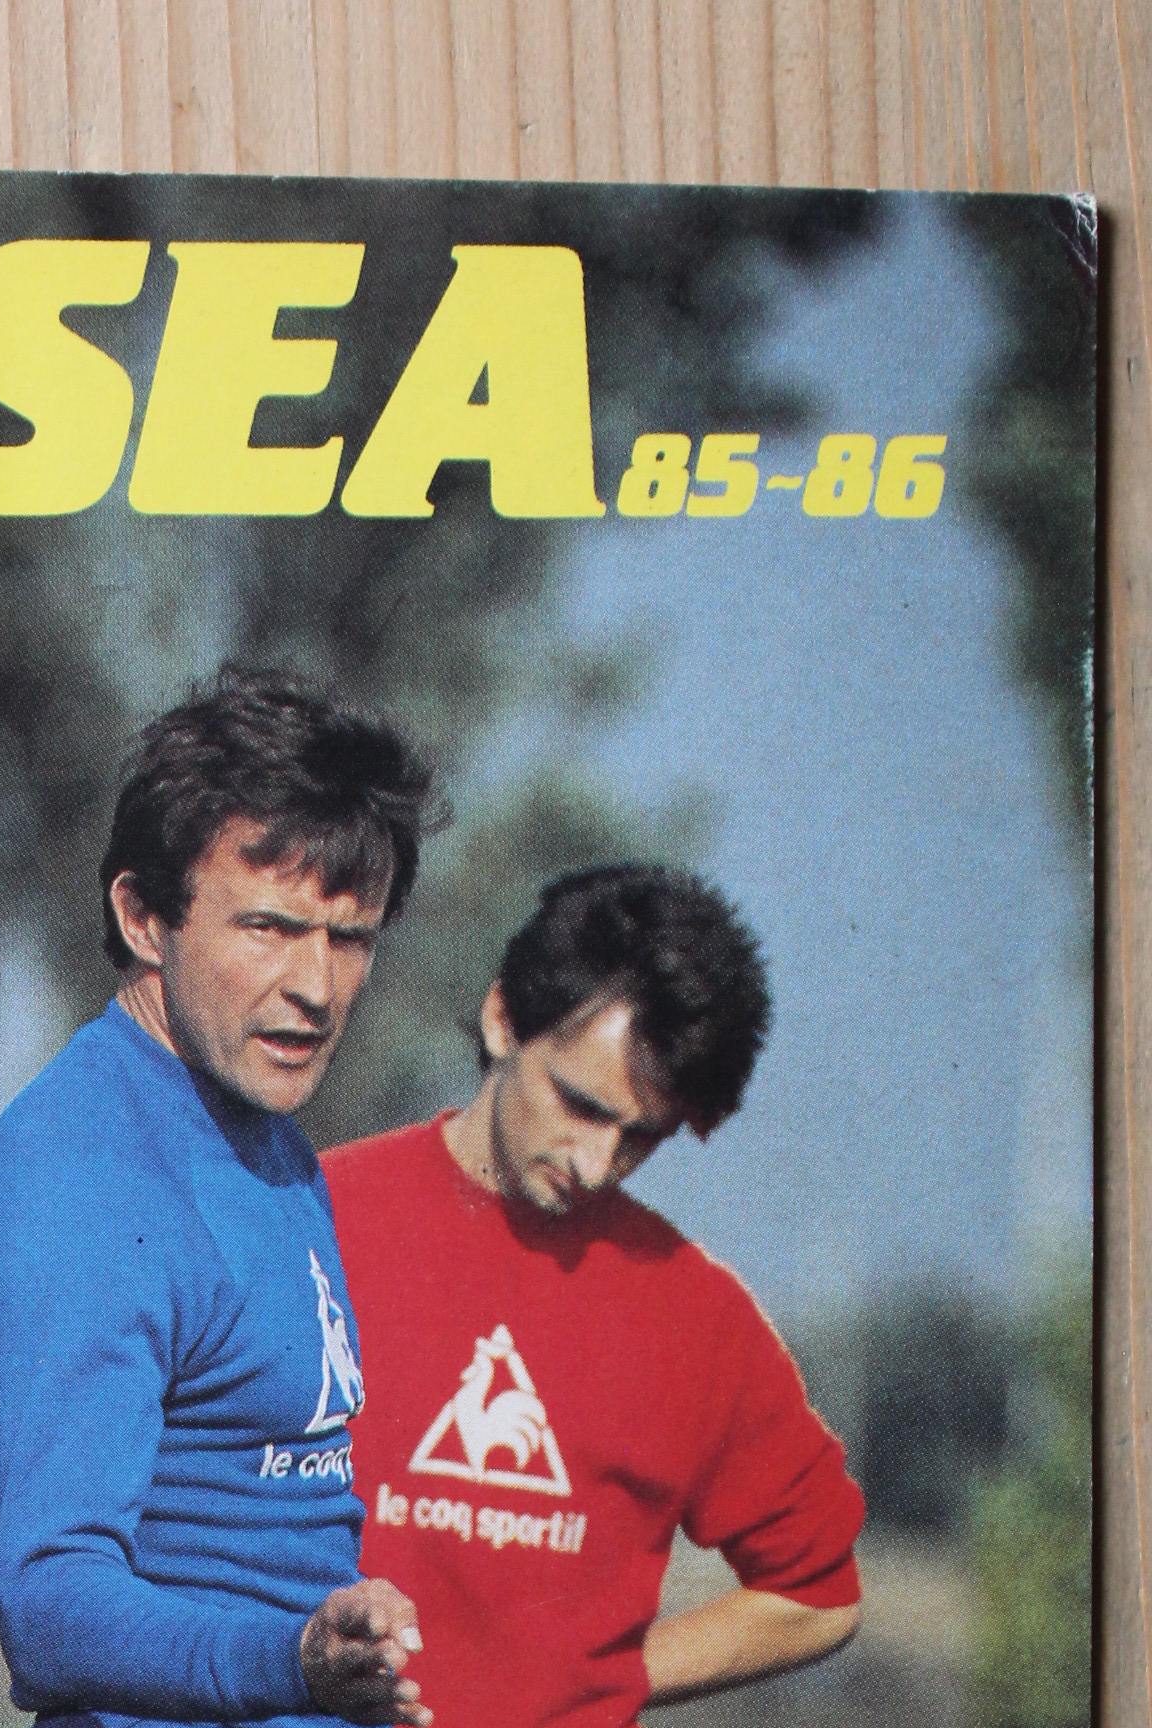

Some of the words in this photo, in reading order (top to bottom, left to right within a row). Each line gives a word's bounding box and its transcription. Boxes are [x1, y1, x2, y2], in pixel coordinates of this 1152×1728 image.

[260, 1444, 292, 1478] le
[375, 1483, 409, 1526] le
[412, 1497, 473, 1541] coq
